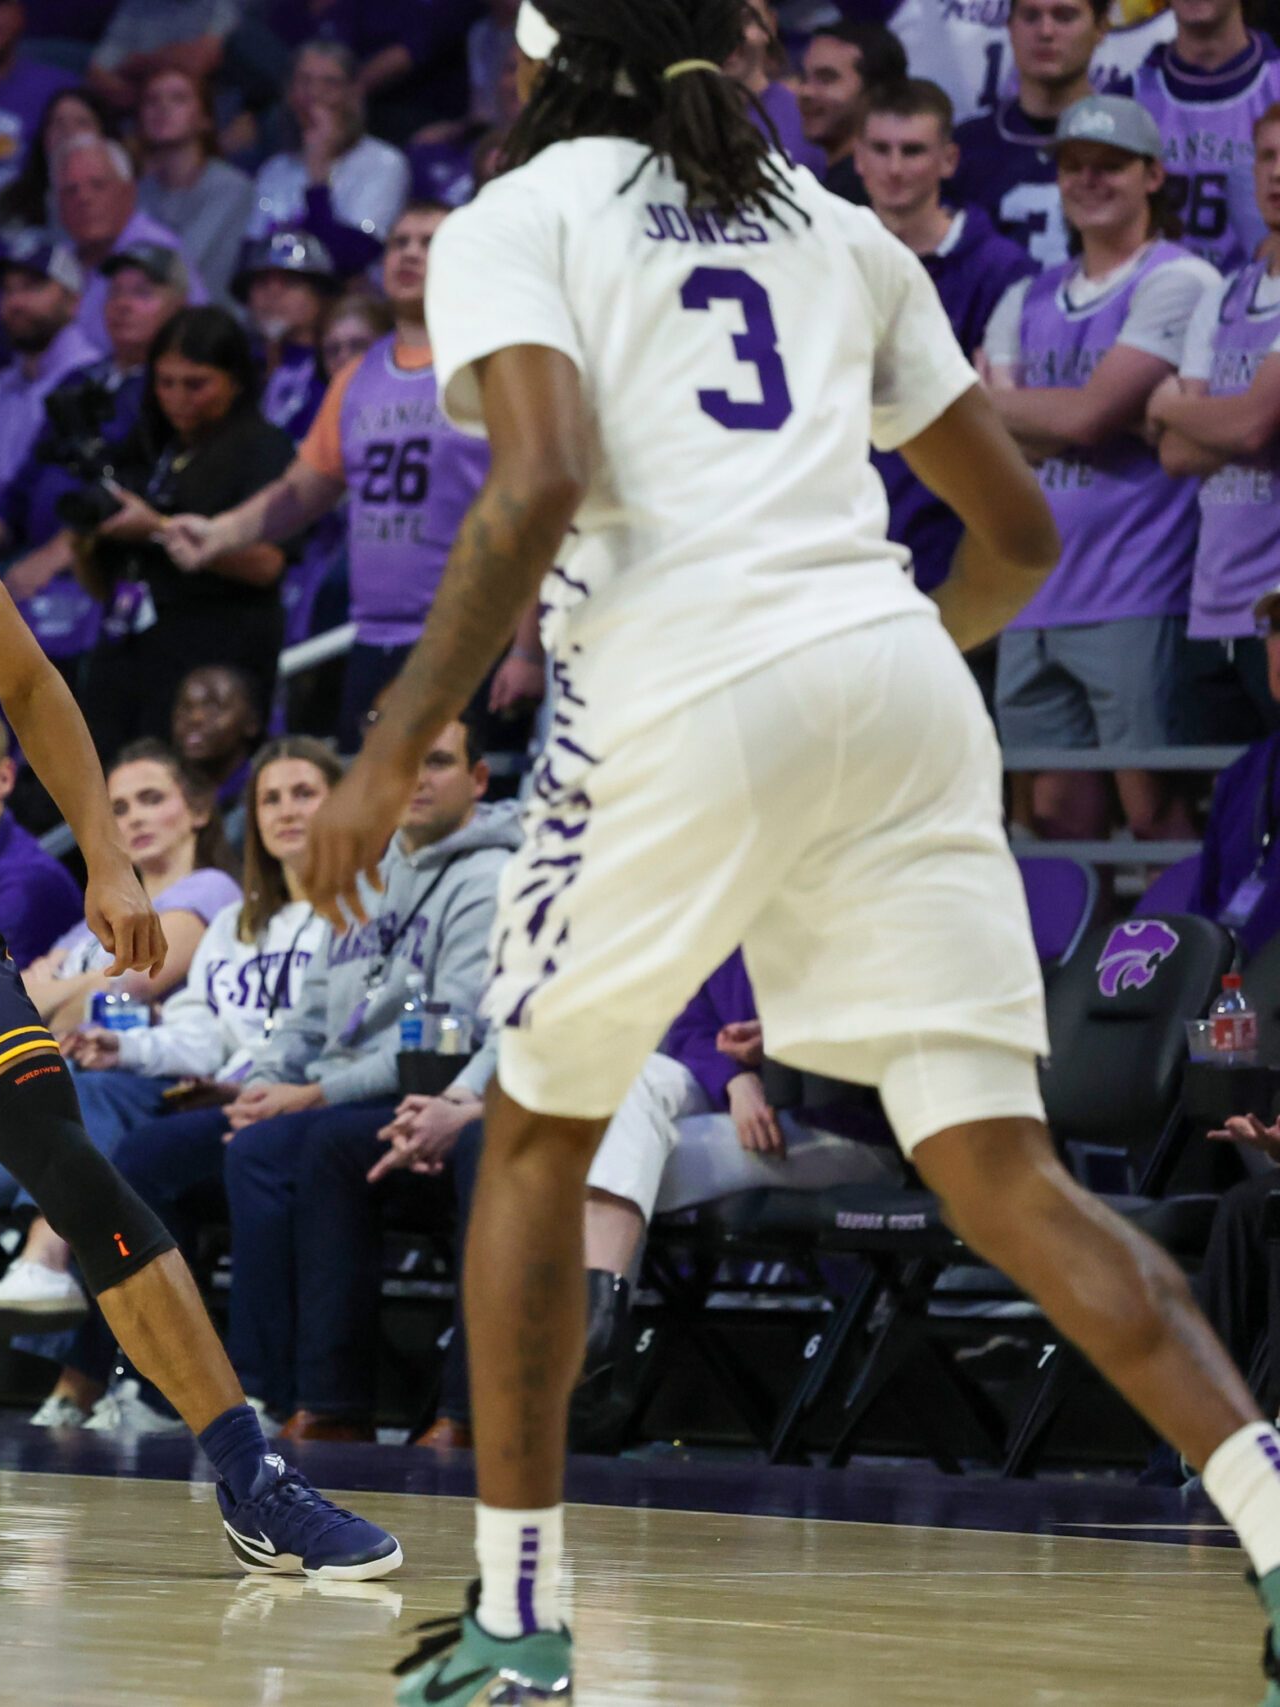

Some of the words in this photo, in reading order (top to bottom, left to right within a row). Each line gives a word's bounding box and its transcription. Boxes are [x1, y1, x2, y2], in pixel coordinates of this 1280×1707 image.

[680, 266, 793, 432] 3
[362, 437, 431, 505] 26
[636, 1328, 655, 1353] 5
[804, 1334, 822, 1359] 6
[1037, 1344, 1057, 1368] 7
